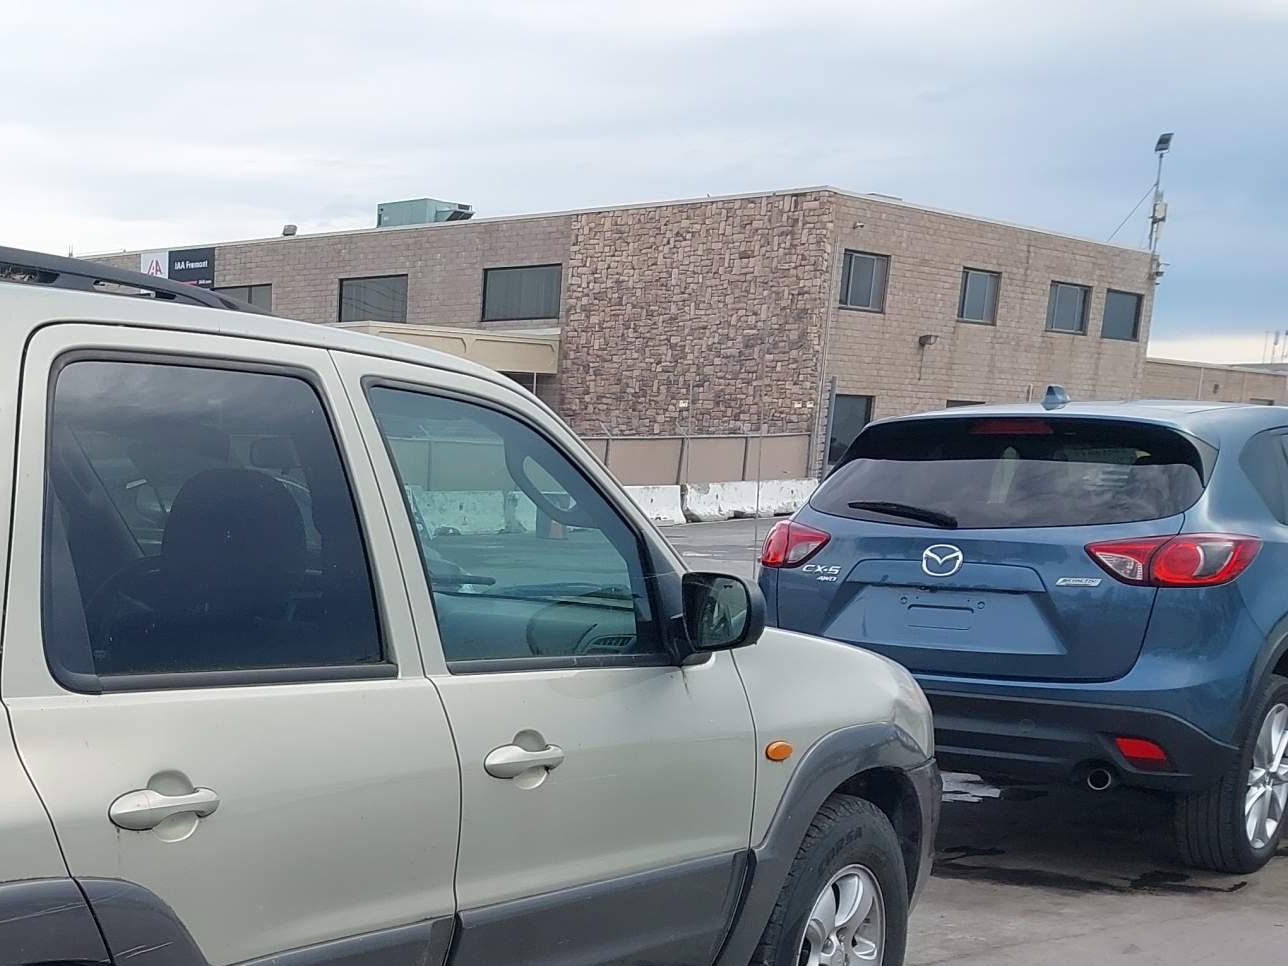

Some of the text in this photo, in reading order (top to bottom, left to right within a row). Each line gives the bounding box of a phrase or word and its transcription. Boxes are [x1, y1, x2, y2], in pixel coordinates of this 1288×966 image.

[174, 260, 208, 270] IAA Fremont
[802, 564, 841, 575] CX-5
